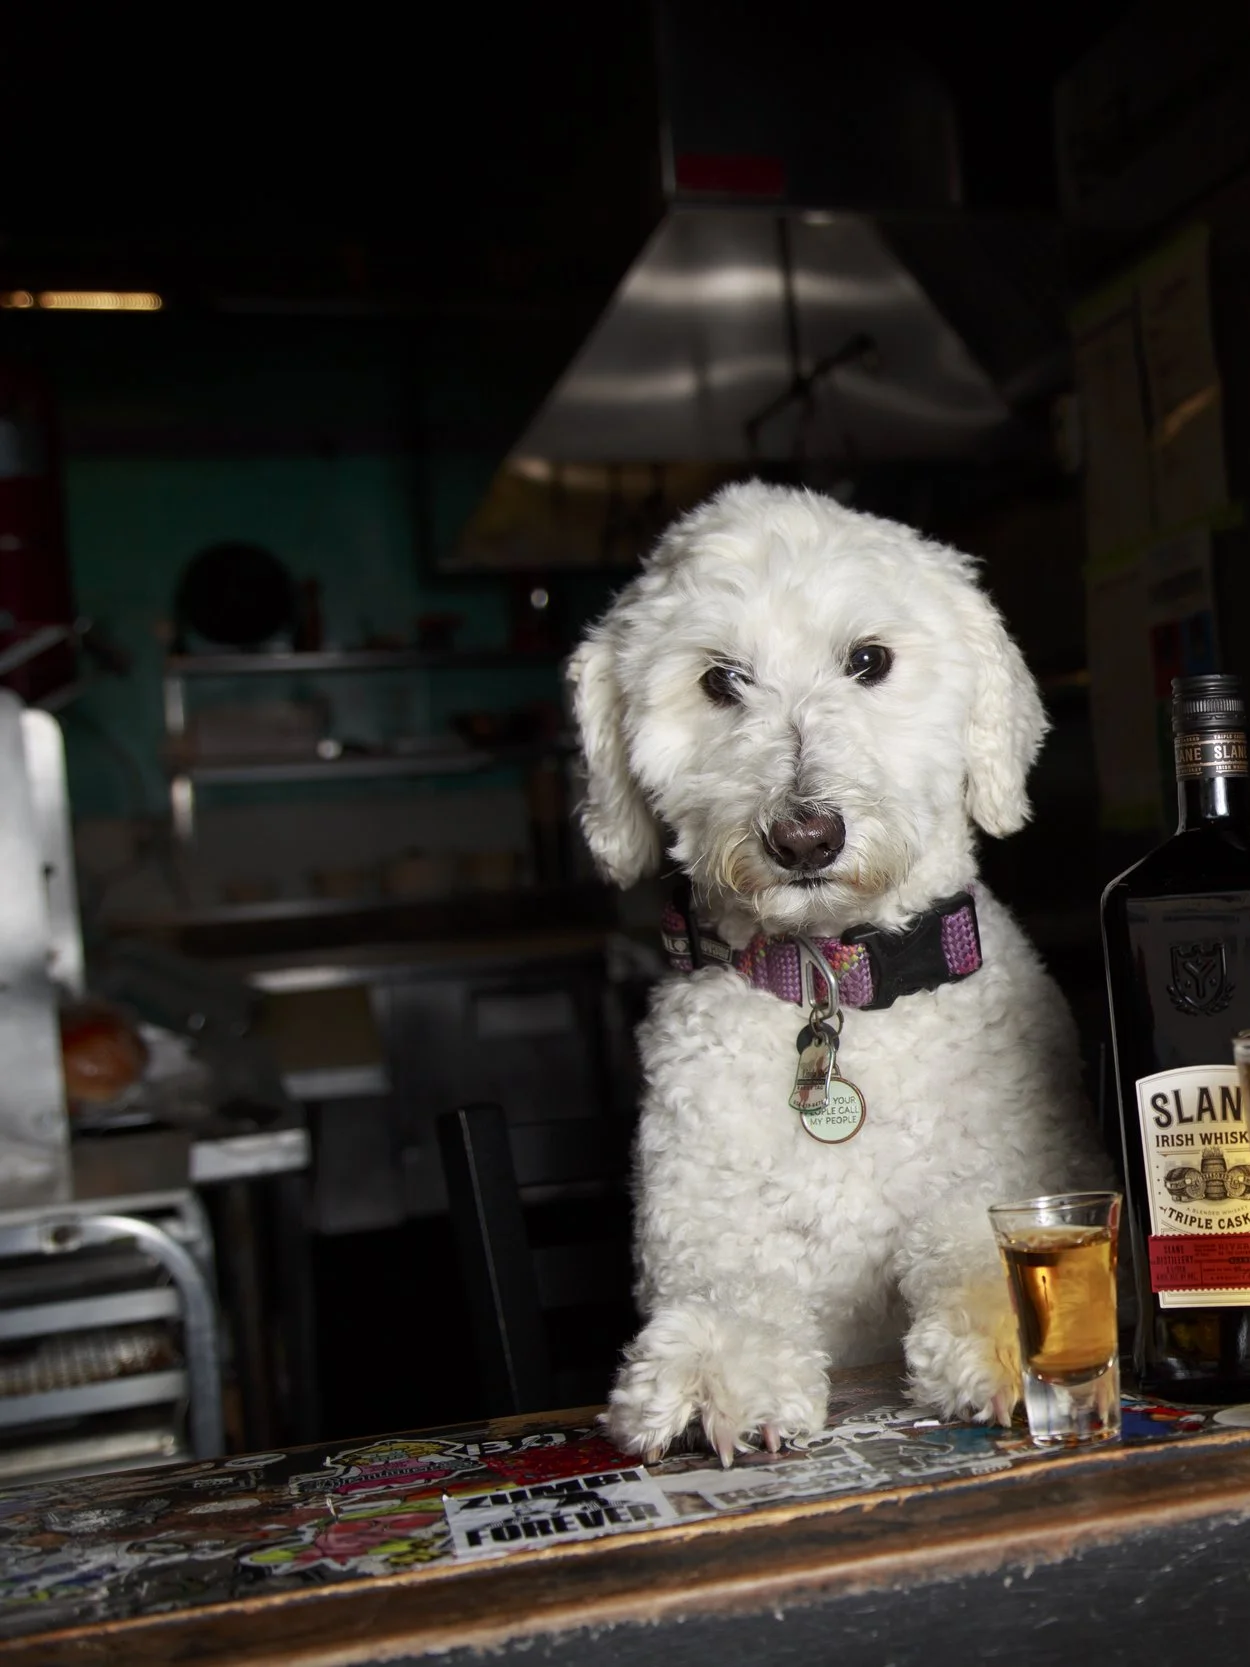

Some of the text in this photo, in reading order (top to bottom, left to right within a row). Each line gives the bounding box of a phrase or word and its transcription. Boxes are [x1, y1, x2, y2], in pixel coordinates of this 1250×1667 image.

[832, 1096, 857, 1106] YOUR
[838, 1105, 860, 1115] CALL
[1151, 1085, 1242, 1128] SLAN
[810, 1115, 858, 1126] MY PEOPLE
[1155, 1130, 1250, 1148] IRISH WHISK
[1167, 1206, 1213, 1230] TRIPLE
[467, 1503, 662, 1547] FOREVER
